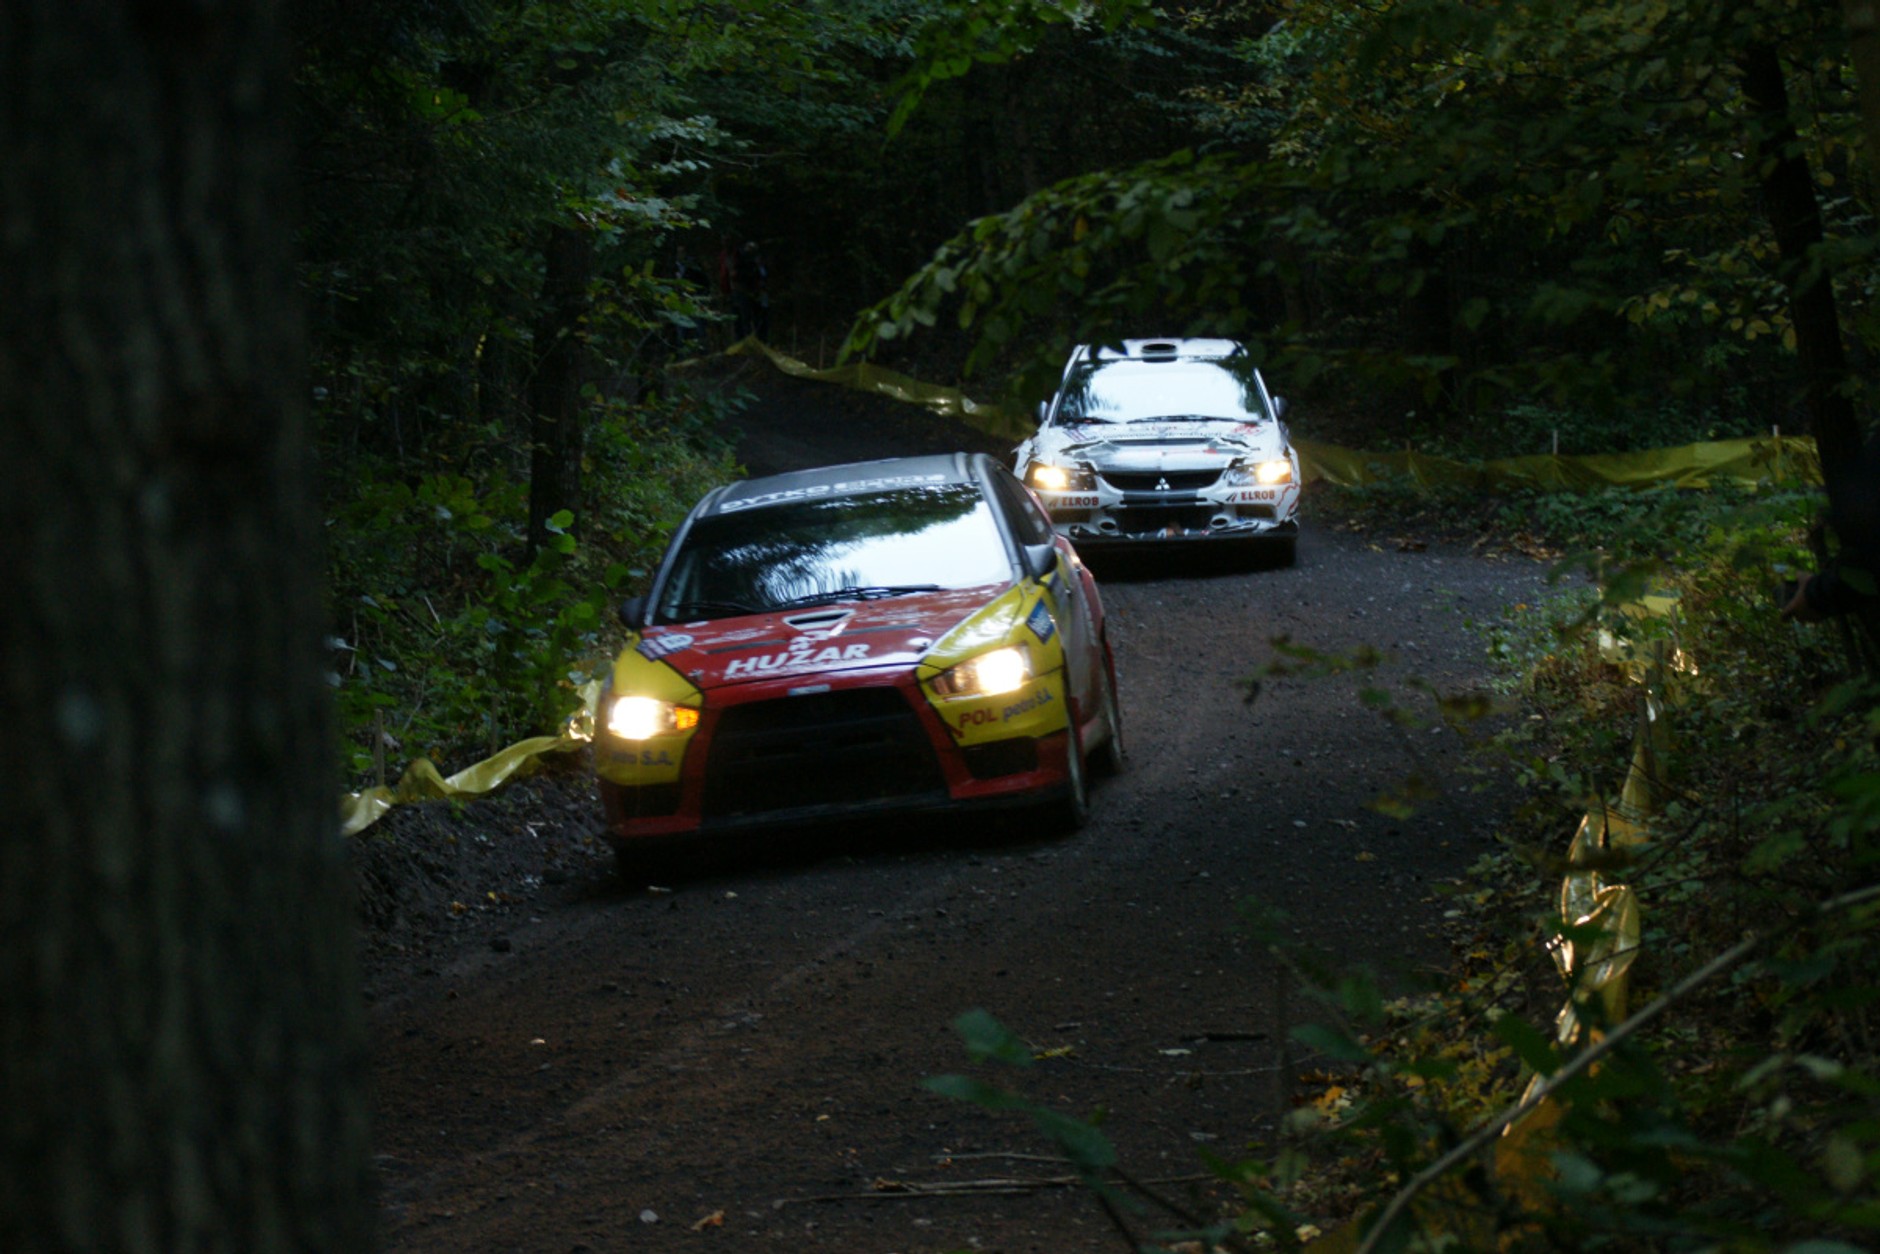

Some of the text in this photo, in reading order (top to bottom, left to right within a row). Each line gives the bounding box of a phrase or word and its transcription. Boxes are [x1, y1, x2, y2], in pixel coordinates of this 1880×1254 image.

[1061, 496, 1100, 507] ELROB
[1241, 490, 1276, 501] ELROB
[723, 643, 871, 676] HUZAR
[959, 708, 999, 728] POL
